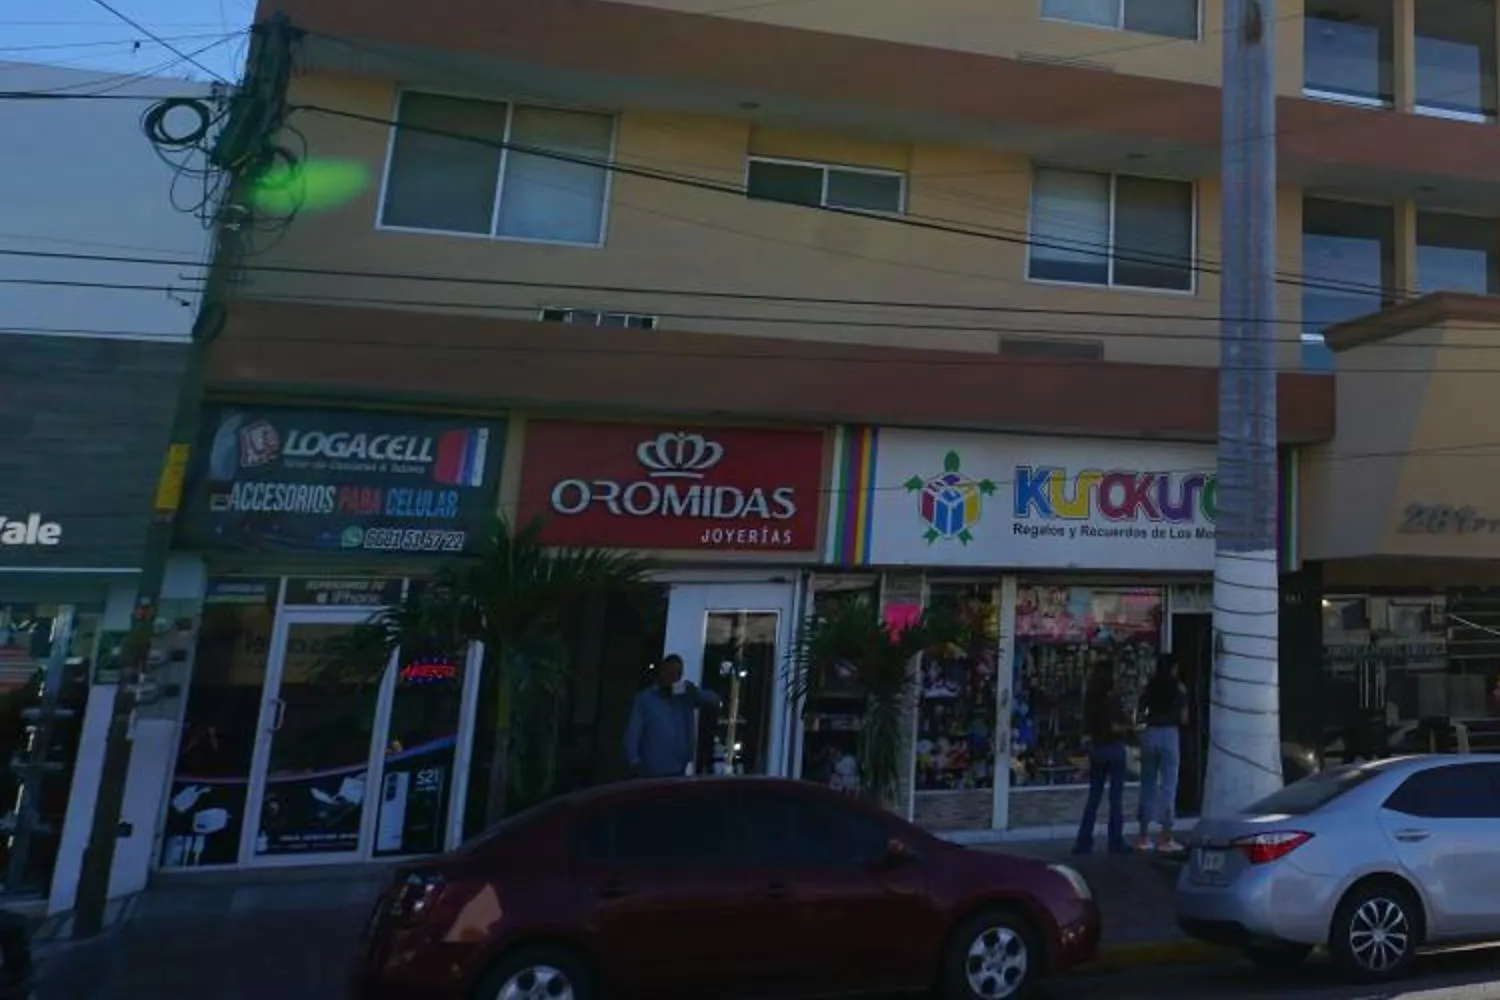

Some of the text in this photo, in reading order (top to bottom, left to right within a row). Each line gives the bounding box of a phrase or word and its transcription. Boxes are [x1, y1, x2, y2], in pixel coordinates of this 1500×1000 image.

[282, 428, 433, 462] LOGACELL
[231, 481, 460, 519] ACCESORIOS PARA CELULAR
[550, 477, 797, 520] OROMIDAS
[701, 526, 792, 545] JOYERÍAS
[1013, 523, 1065, 540] Regalos
[1068, 526, 1077, 540] y
[1080, 524, 1148, 540] Recuerdos
[1151, 526, 1166, 539] de
[1170, 527, 1192, 540] Los
